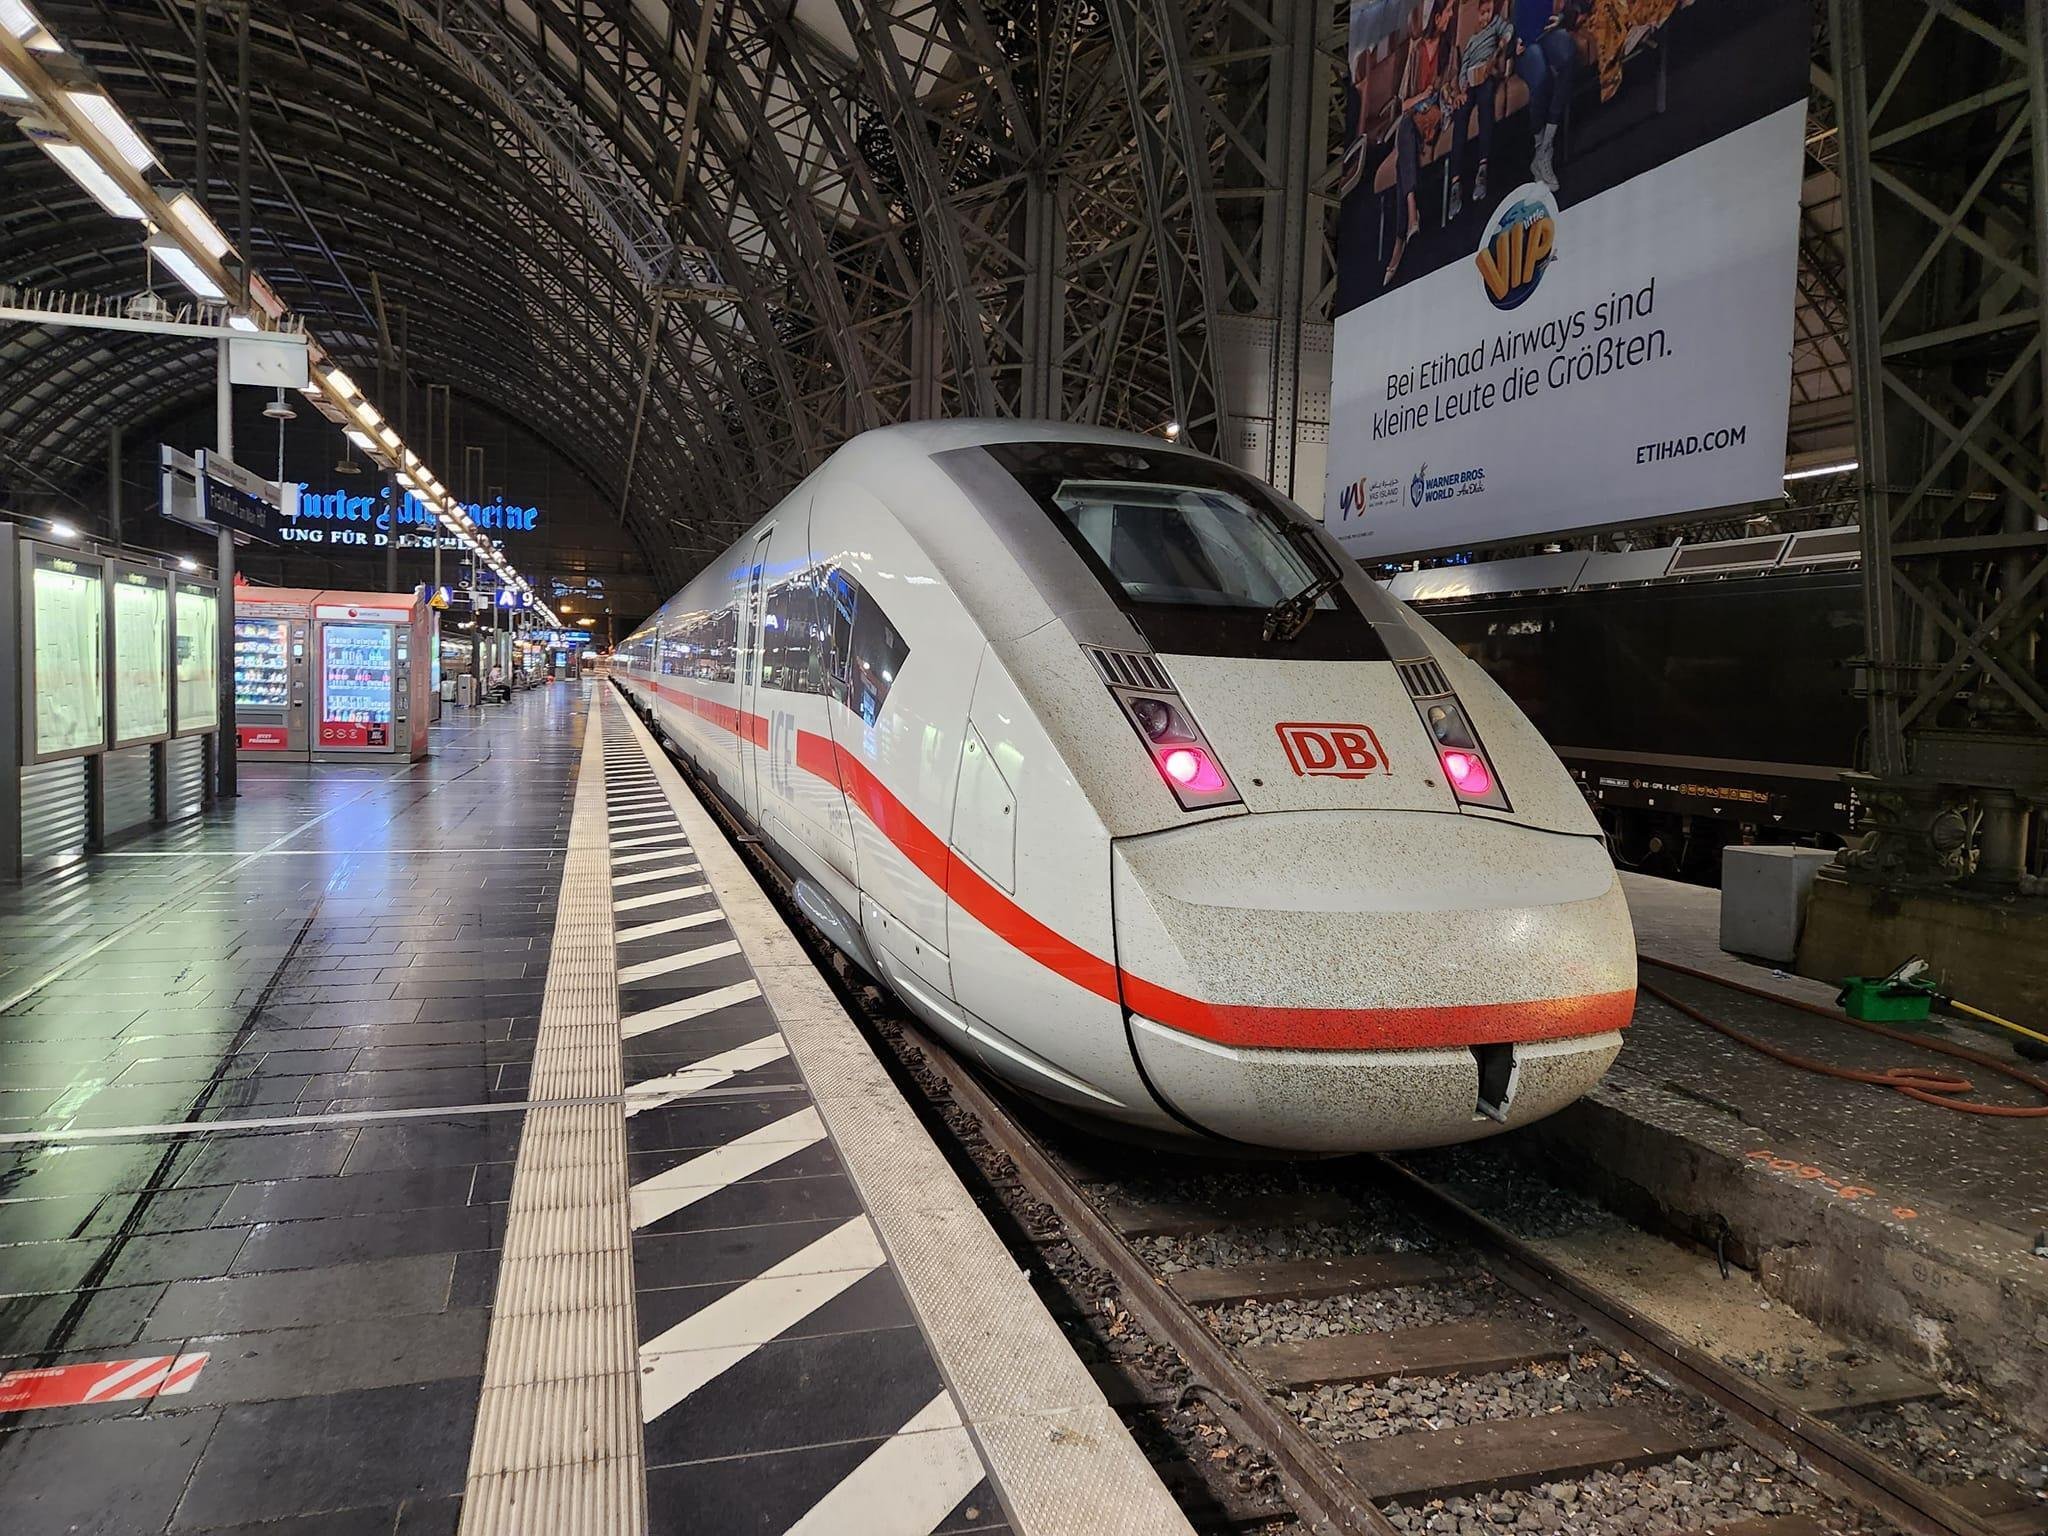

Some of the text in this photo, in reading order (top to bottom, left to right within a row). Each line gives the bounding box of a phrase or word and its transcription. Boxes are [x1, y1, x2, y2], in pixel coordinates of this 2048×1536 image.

[1475, 216, 1555, 300] VIP
[1387, 277, 1655, 401] Bei Etihad Airways sind
[1372, 328, 1672, 441] kleine Leute die Größten.
[1636, 425, 1746, 464] ETIHAD.COM
[1425, 468, 1486, 490] WARNER BROS.
[1425, 487, 1454, 503] WORLD
[331, 527, 369, 546] FÜR
[499, 589, 534, 607] A 9
[1289, 731, 1378, 770] DB
